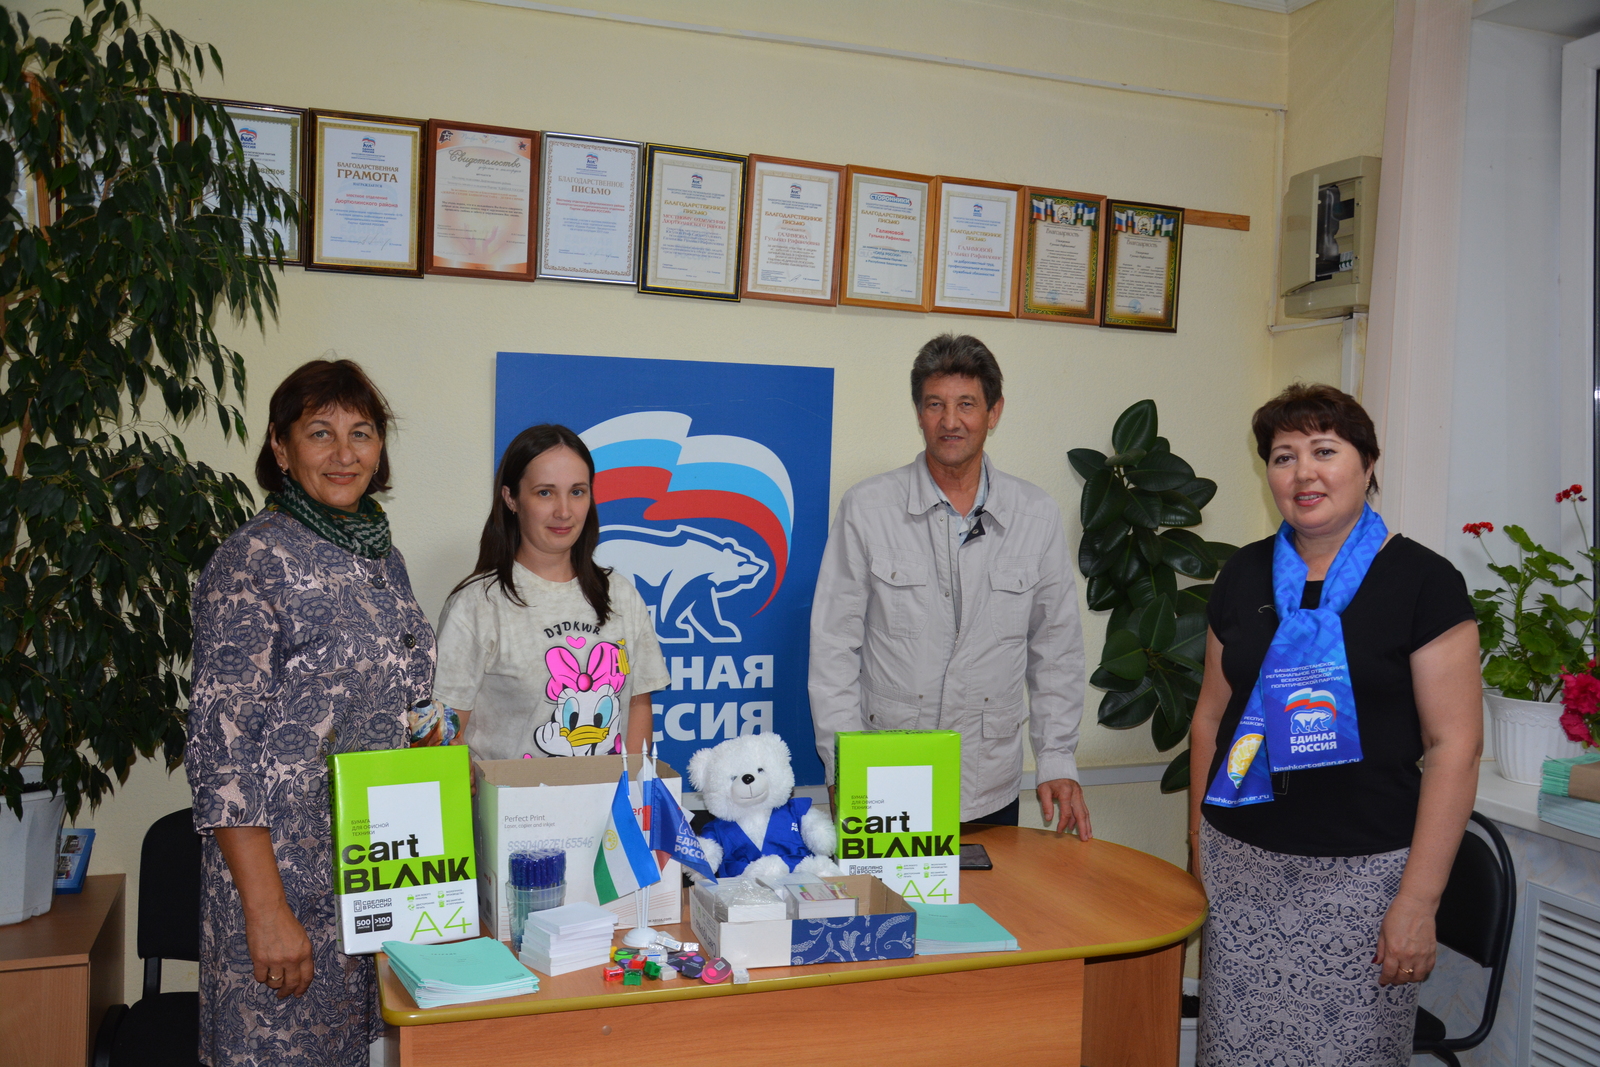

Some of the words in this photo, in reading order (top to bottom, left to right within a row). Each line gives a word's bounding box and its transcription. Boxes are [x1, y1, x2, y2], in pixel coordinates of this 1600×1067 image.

[449, 149, 521, 168] Свидетельство
[337, 162, 399, 172] БЛАГОДАРСТВЕННАЯ
[337, 169, 398, 183] ГРАМОТА
[558, 176, 624, 188] БЛАГОДАРСТВЕННОЕ
[571, 185, 611, 196] ПИСЬМО
[664, 200, 726, 211] БЛАГОДАРСТВЕННОЕ
[870, 194, 910, 205] СТОРОННИКИ
[765, 211, 823, 222] БЛАГОДАРСТВЕННОЕ
[861, 210, 917, 221] БЛАГОДАРСТВЕННОЕ
[544, 621, 600, 638] DJDKWR
[662, 655, 774, 691] НАЯ
[1271, 680, 1318, 688] ПОЛИТИЧЕСКОЙ
[1290, 732, 1336, 744] ЕДИНАЯ
[1291, 741, 1337, 754] РОССИЯ
[1274, 758, 1360, 772] bashkortostan.er.ru
[842, 811, 909, 834] cart
[342, 834, 419, 865] cart
[842, 835, 954, 858] BLANK
[343, 857, 470, 894] BLANK
[410, 906, 472, 941] A4
